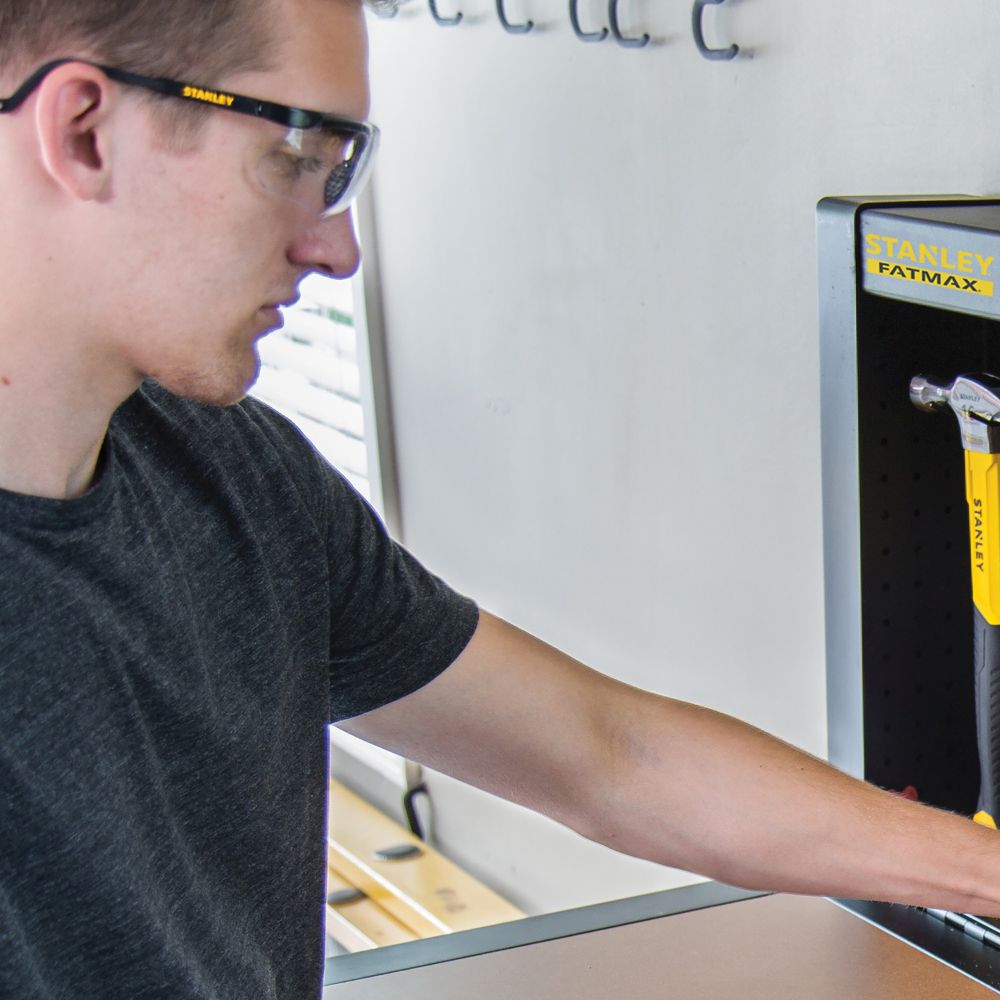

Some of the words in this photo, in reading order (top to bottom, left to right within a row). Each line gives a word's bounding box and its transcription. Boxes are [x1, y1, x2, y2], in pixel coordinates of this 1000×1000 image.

[183, 86, 234, 106] STANLEY
[865, 233, 995, 275] STANLEY
[878, 262, 980, 292] FATMAX
[973, 498, 984, 572] STANLEY
